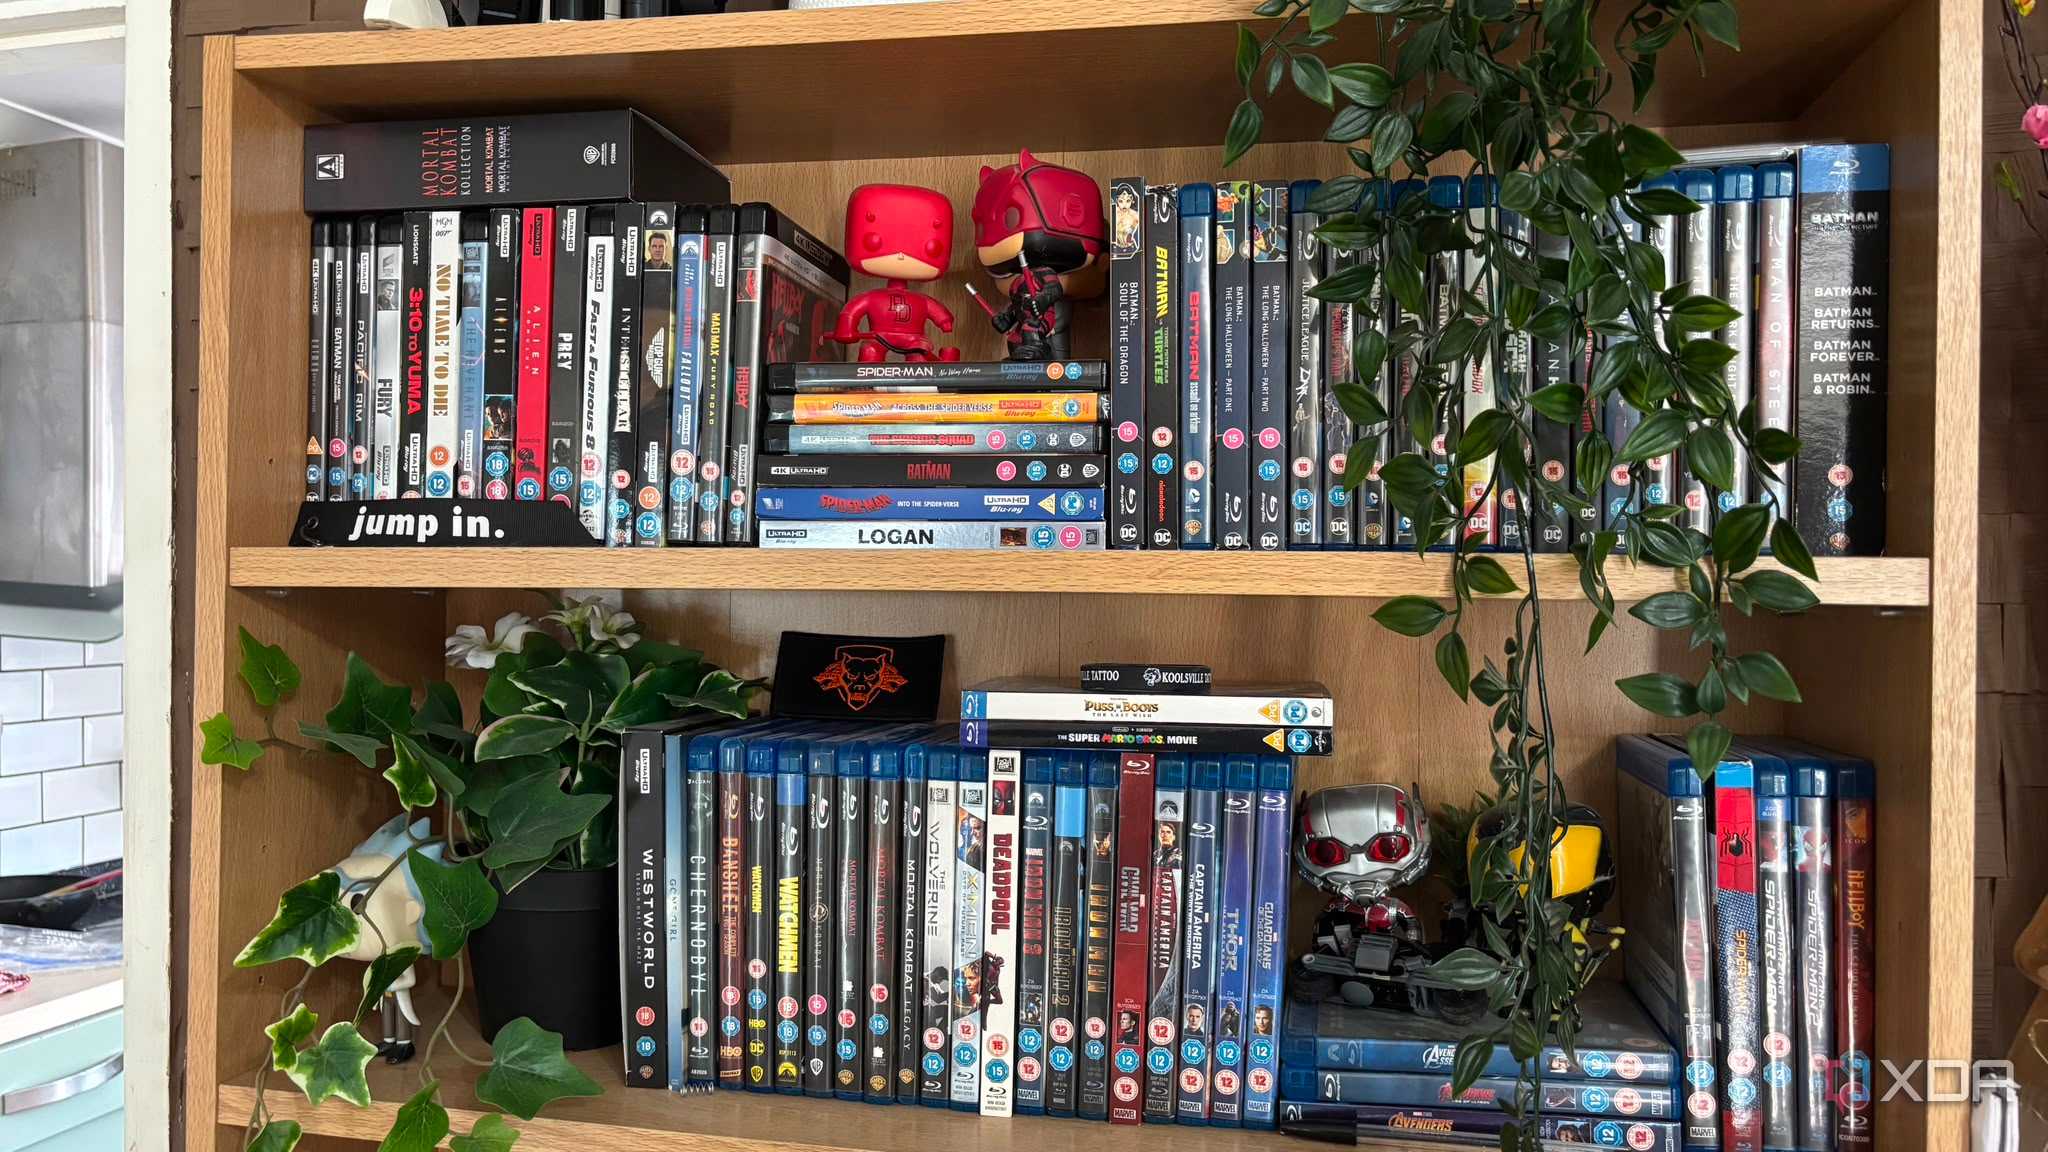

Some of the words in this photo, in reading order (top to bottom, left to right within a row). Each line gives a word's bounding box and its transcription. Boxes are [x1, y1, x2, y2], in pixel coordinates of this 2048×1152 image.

[460, 125, 471, 195] KOLLECTION
[485, 127, 495, 160] KOMBAT
[498, 125, 508, 159] KOMBAT
[422, 128, 439, 197] MORTAL
[440, 128, 458, 197] KOMBAT
[485, 160, 494, 194] MORTAL
[498, 160, 507, 194] MORTAL
[1810, 211, 1880, 224] BATMAN
[412, 225, 420, 266] LIONSGATE
[435, 264, 452, 292] NO
[1119, 282, 1128, 307] SOUL
[1154, 246, 1168, 321] BATMAN
[1224, 286, 1233, 301] THE
[1261, 285, 1269, 300] THE
[1771, 259, 1783, 303] MAN
[1814, 286, 1872, 297] BATMAN
[408, 288, 424, 333] 3:10
[434, 296, 451, 346] TIME
[589, 300, 601, 345] FAST
[710, 313, 721, 335] MAD
[1119, 310, 1128, 323] OF
[1224, 303, 1233, 323] LONG
[1261, 301, 1269, 321] LONG
[1811, 319, 1875, 330] RETURNS
[1814, 307, 1872, 318] BATMAN
[334, 327, 342, 369] BATMAN
[531, 305, 541, 375] ALIEN
[557, 332, 573, 370] PREY
[654, 341, 664, 358] TOP
[710, 335, 720, 357] MAX
[1119, 325, 1128, 343] THE
[1189, 291, 1200, 381] BATMAN
[1224, 324, 1233, 369] HALLOWEEN
[1261, 323, 1269, 368] HALLOWEEN
[1300, 322, 1310, 361] LEAGUE
[1769, 321, 1782, 348] OF
[1814, 340, 1871, 351] BATMAN
[434, 352, 449, 380] TO
[617, 308, 632, 430] INTERSTELLAR
[653, 358, 663, 375] GUN
[857, 366, 934, 377] SPIDER-MAN
[1119, 345, 1128, 384] DRAGON
[1154, 327, 1163, 385] TURTLES
[1810, 351, 1875, 362] FOREVER
[407, 352, 423, 415] YUMA
[586, 356, 598, 432] FURIOUS
[680, 351, 692, 401] FALLOUT
[1224, 378, 1232, 396] PART
[1261, 377, 1269, 395] PART
[1295, 366, 1311, 403] DARK
[1813, 373, 1871, 384] BATMAN
[1813, 384, 1823, 395] &
[1826, 384, 1870, 395] ROBIN
[355, 393, 363, 422] RIM
[377, 378, 393, 418] FURY
[433, 384, 448, 417] DIE
[832, 400, 883, 416] SPIDER-MAN
[891, 403, 922, 412] ACROSS
[925, 403, 938, 412] THE
[941, 403, 993, 412] SPIDER-VERSE
[1224, 397, 1233, 413] ONE
[1261, 397, 1269, 412] TWO
[1768, 369, 1781, 426] STEE
[586, 434, 596, 451] 8
[937, 434, 974, 446] SQUAD
[907, 460, 951, 481] BATMAN
[897, 500, 911, 508] INTO
[912, 500, 922, 508] THE
[923, 500, 959, 508] SPIDER-VERSE
[989, 505, 1023, 514] Blu-ray
[1158, 480, 1166, 523] nickelodeon
[348, 505, 439, 543] jump
[452, 505, 505, 539] in.
[858, 528, 934, 546] LOGAN
[1091, 670, 1119, 681] TATTOO
[1162, 671, 1204, 684] KOOLSVILLE
[1084, 699, 1114, 713] PUSS
[1122, 700, 1159, 713] BOOTS
[1068, 733, 1100, 743] SUPER
[1102, 733, 1135, 744] MARIO
[1166, 735, 1198, 745] MOVIE
[722, 837, 739, 913] BANSHEE
[751, 865, 762, 913] WATCHMEN
[848, 859, 856, 899] MORTAL
[906, 859, 915, 919] MORTAL
[927, 820, 940, 937] WOLVERINE
[991, 833, 1013, 935] DEADPOOL
[1023, 859, 1044, 900] IRON
[1121, 866, 1141, 898] CIVIL
[1194, 863, 1205, 914] CAPTAIN
[1089, 884, 1109, 939] IRON
[1160, 871, 1173, 916] CAPTAIN
[1847, 870, 1865, 930] HELLBOY
[643, 849, 654, 990] WESTWORLD
[690, 856, 706, 998] CHERNOBYL
[778, 876, 799, 973] WATCHMEN
[848, 900, 856, 936] KOMBAT
[875, 905, 885, 960] KOMBAT
[1023, 904, 1044, 940] MAN
[1053, 906, 1072, 949] IRON
[1121, 901, 1140, 933] WAR
[1158, 919, 1172, 969] AMERICA
[1191, 916, 1203, 970] AMERICA
[1225, 908, 1240, 971] THOR
[1262, 902, 1274, 970] GUARDIANS
[1765, 879, 1777, 1014] SPIDER-MAN
[1807, 888, 1818, 1009] SPIDER-MAN
[905, 928, 915, 993] KOMBAT
[1052, 953, 1071, 991] MAN
[1052, 994, 1070, 1007] 2
[748, 1019, 766, 1029] HBO
[903, 1001, 911, 1050] LEGACY
[1808, 1012, 1820, 1026] 2
[720, 1046, 743, 1057] HBO
[1387, 1111, 1456, 1133] AVENGERS
[1689, 1128, 1717, 1137] MARVEL
